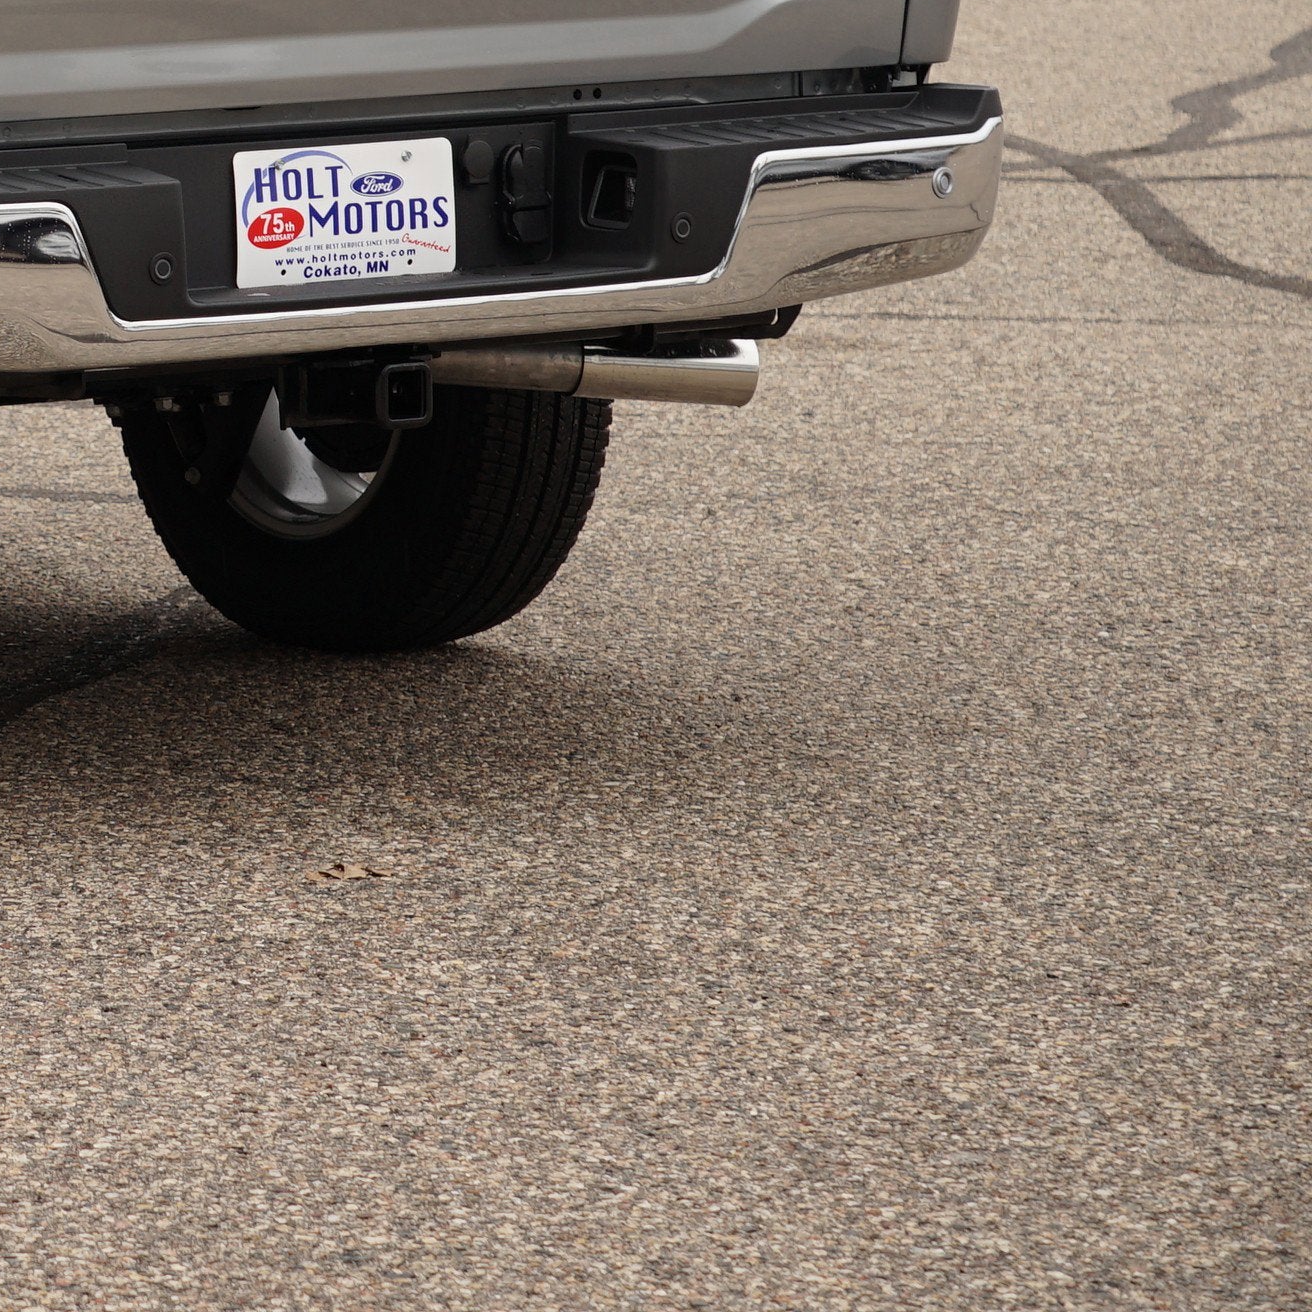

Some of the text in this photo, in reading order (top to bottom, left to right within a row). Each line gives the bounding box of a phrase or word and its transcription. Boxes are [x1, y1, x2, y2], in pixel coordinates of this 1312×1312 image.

[254, 166, 343, 203] HOLT
[360, 174, 394, 194] Ford
[260, 213, 295, 235] 75th
[308, 196, 449, 238] MOTORS
[253, 233, 295, 243] ANNIVERSARY
[326, 242, 339, 250] BEST
[366, 239, 382, 247] SINCE
[401, 232, 451, 253] Guaranteed
[275, 248, 416, 266] www.holtmotors.com
[303, 260, 389, 278] Cokato, MN
